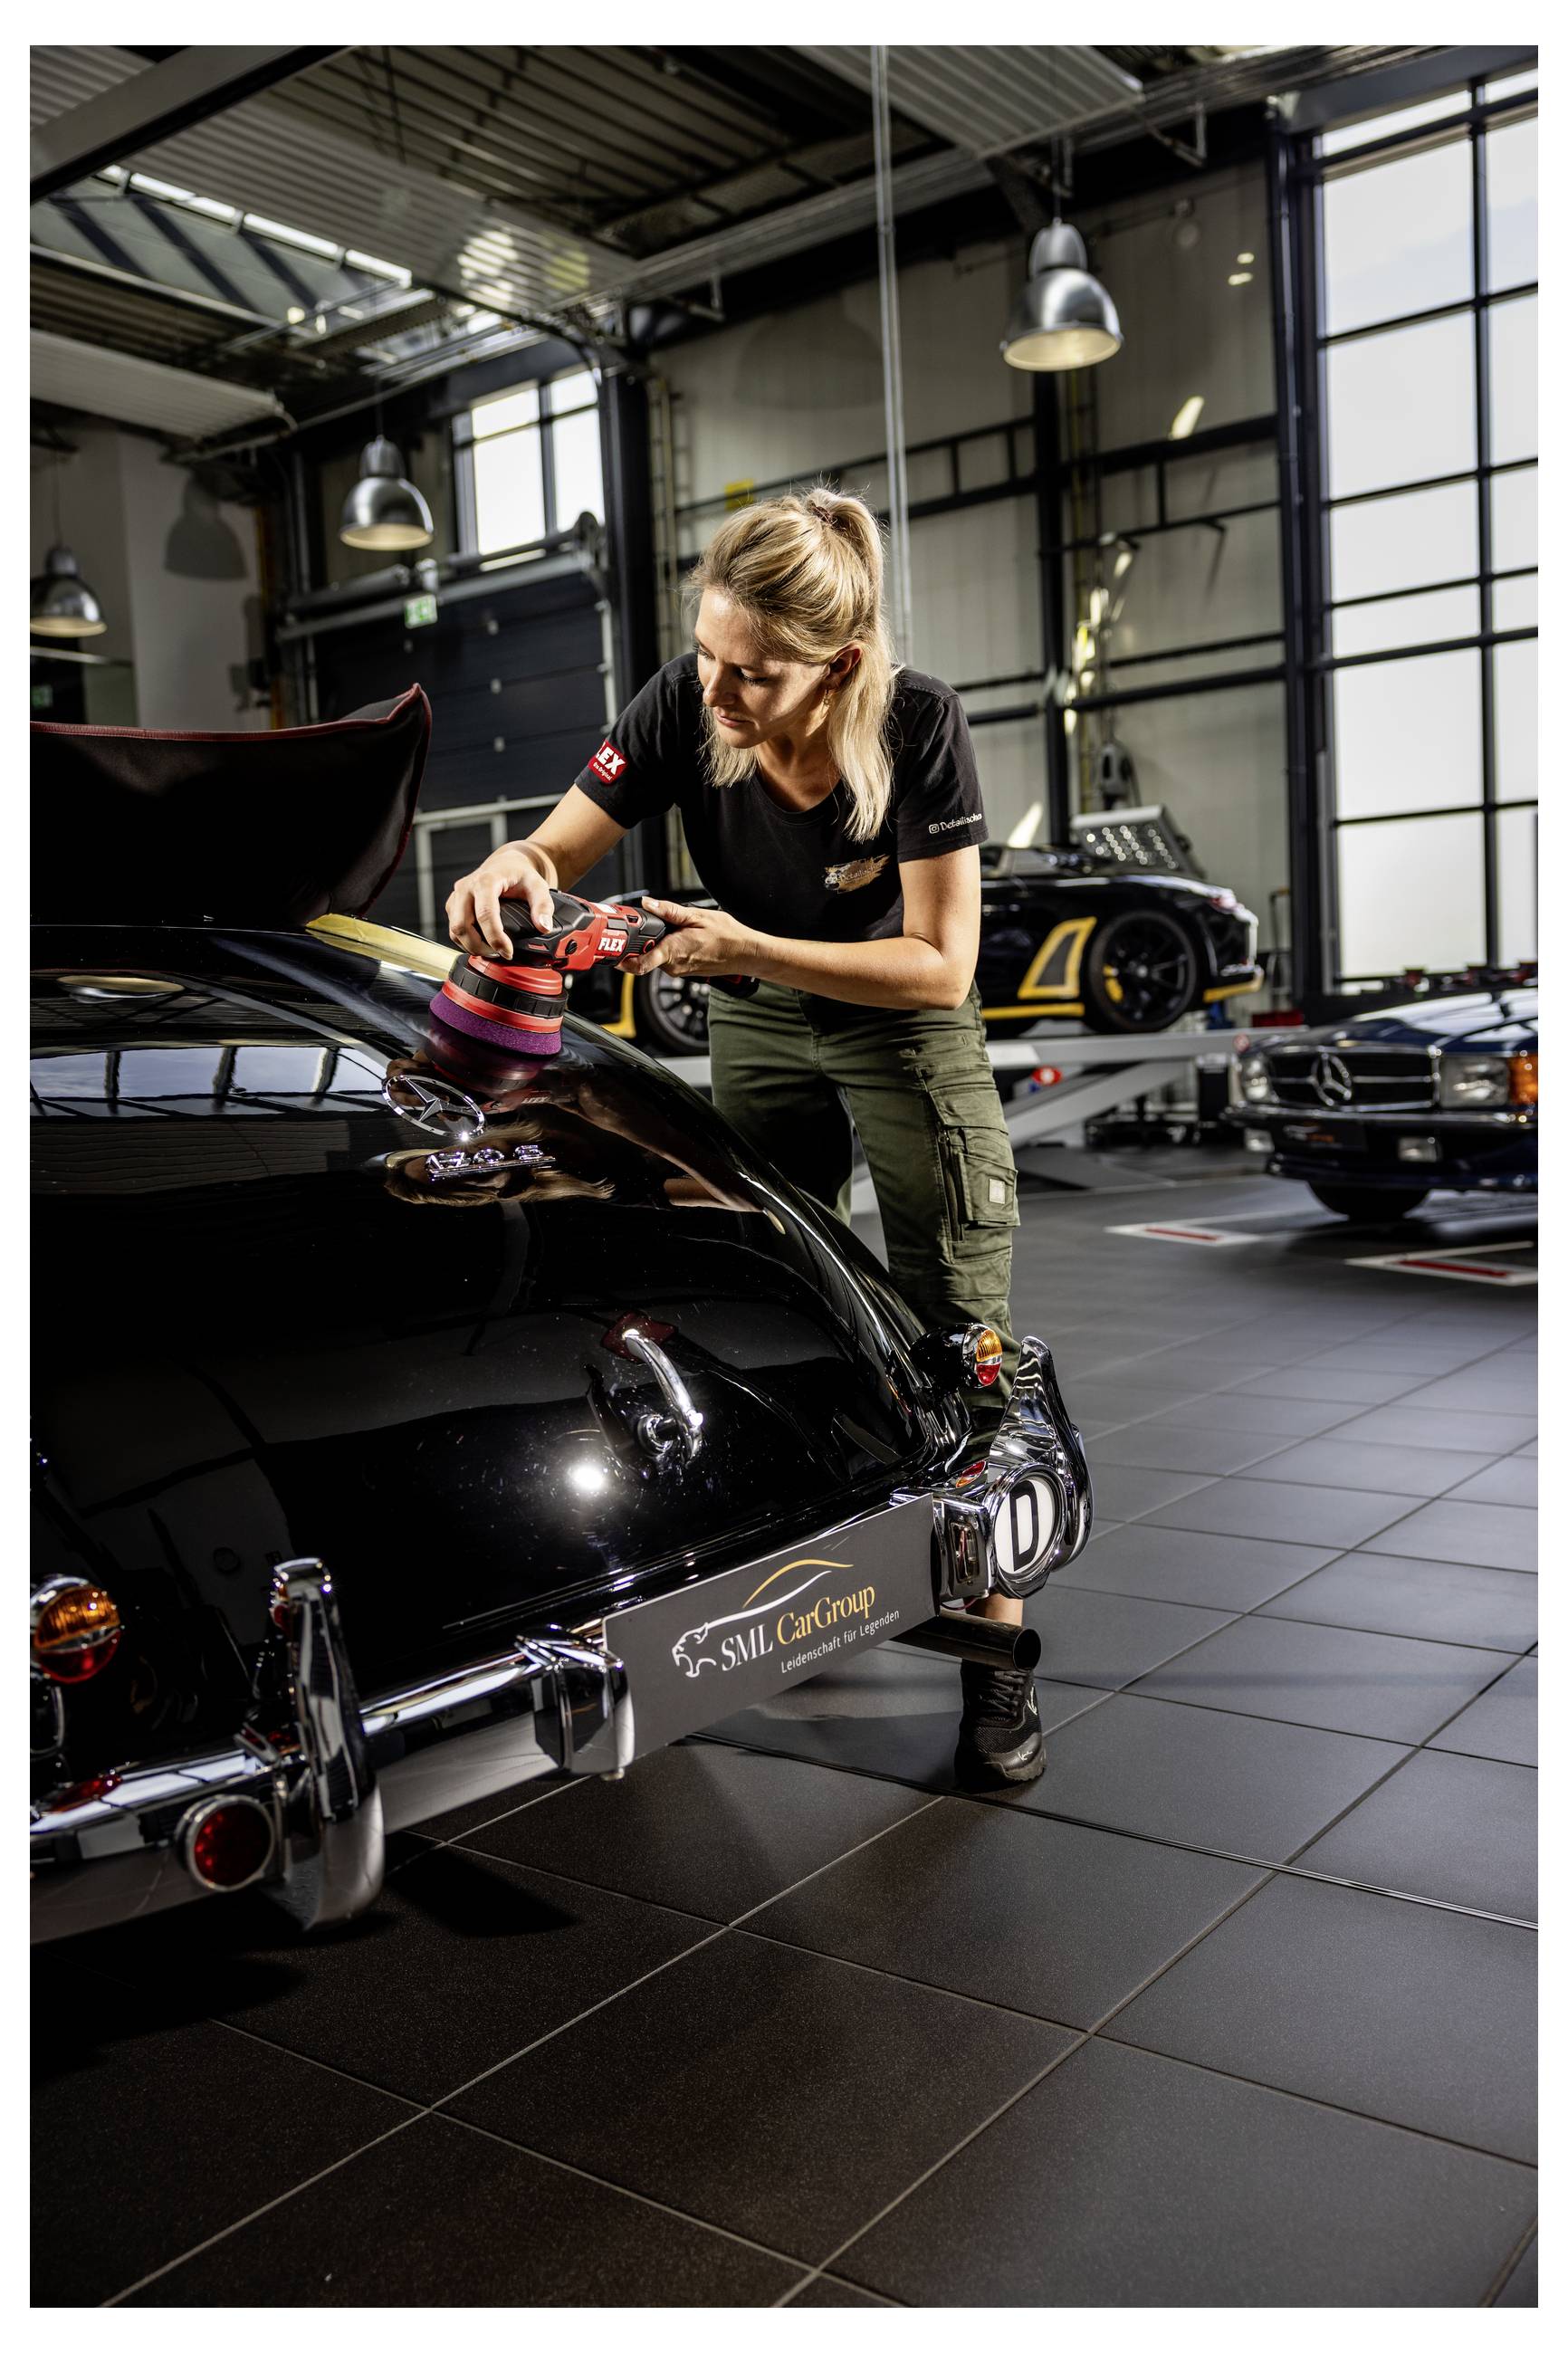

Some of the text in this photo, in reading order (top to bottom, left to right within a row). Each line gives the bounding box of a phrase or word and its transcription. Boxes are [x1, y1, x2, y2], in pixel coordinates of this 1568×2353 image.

[598, 938, 626, 952] FLEX
[1009, 1479, 1039, 1572] D
[721, 1586, 875, 1671] SML CarGroup
[781, 1609, 900, 1673] Leidenschaft für Legenden
